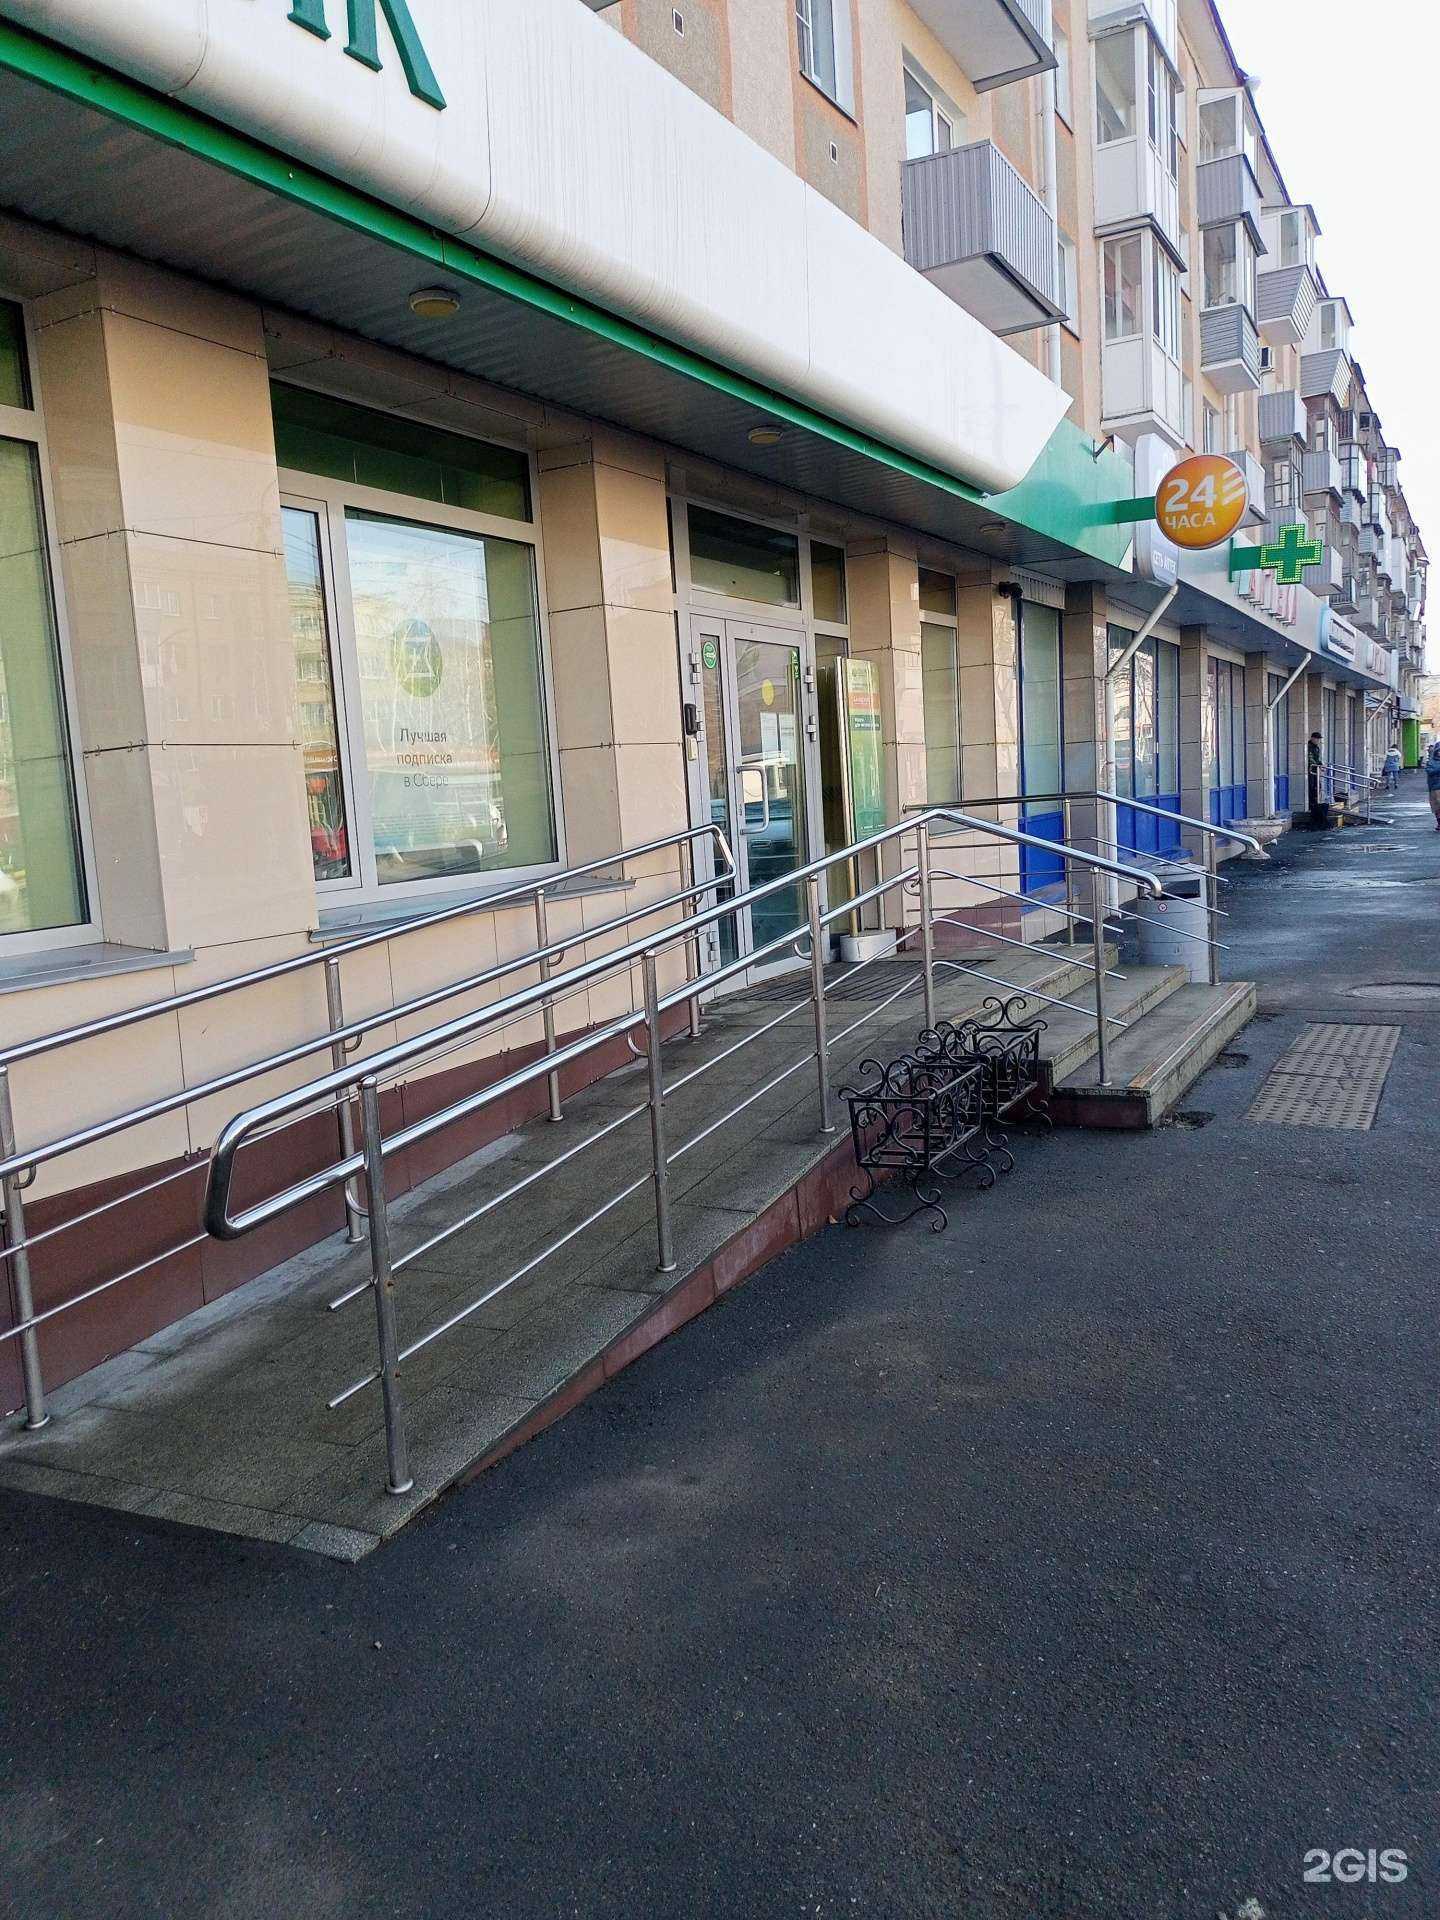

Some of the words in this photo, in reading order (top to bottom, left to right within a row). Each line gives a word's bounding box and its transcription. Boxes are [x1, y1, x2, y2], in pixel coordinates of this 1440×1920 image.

[1165, 474, 1217, 513] 24
[1165, 511, 1216, 530] ЧАСА
[400, 728, 447, 745] Лучшая
[397, 752, 453, 766] подписка
[403, 776, 411, 788] в
